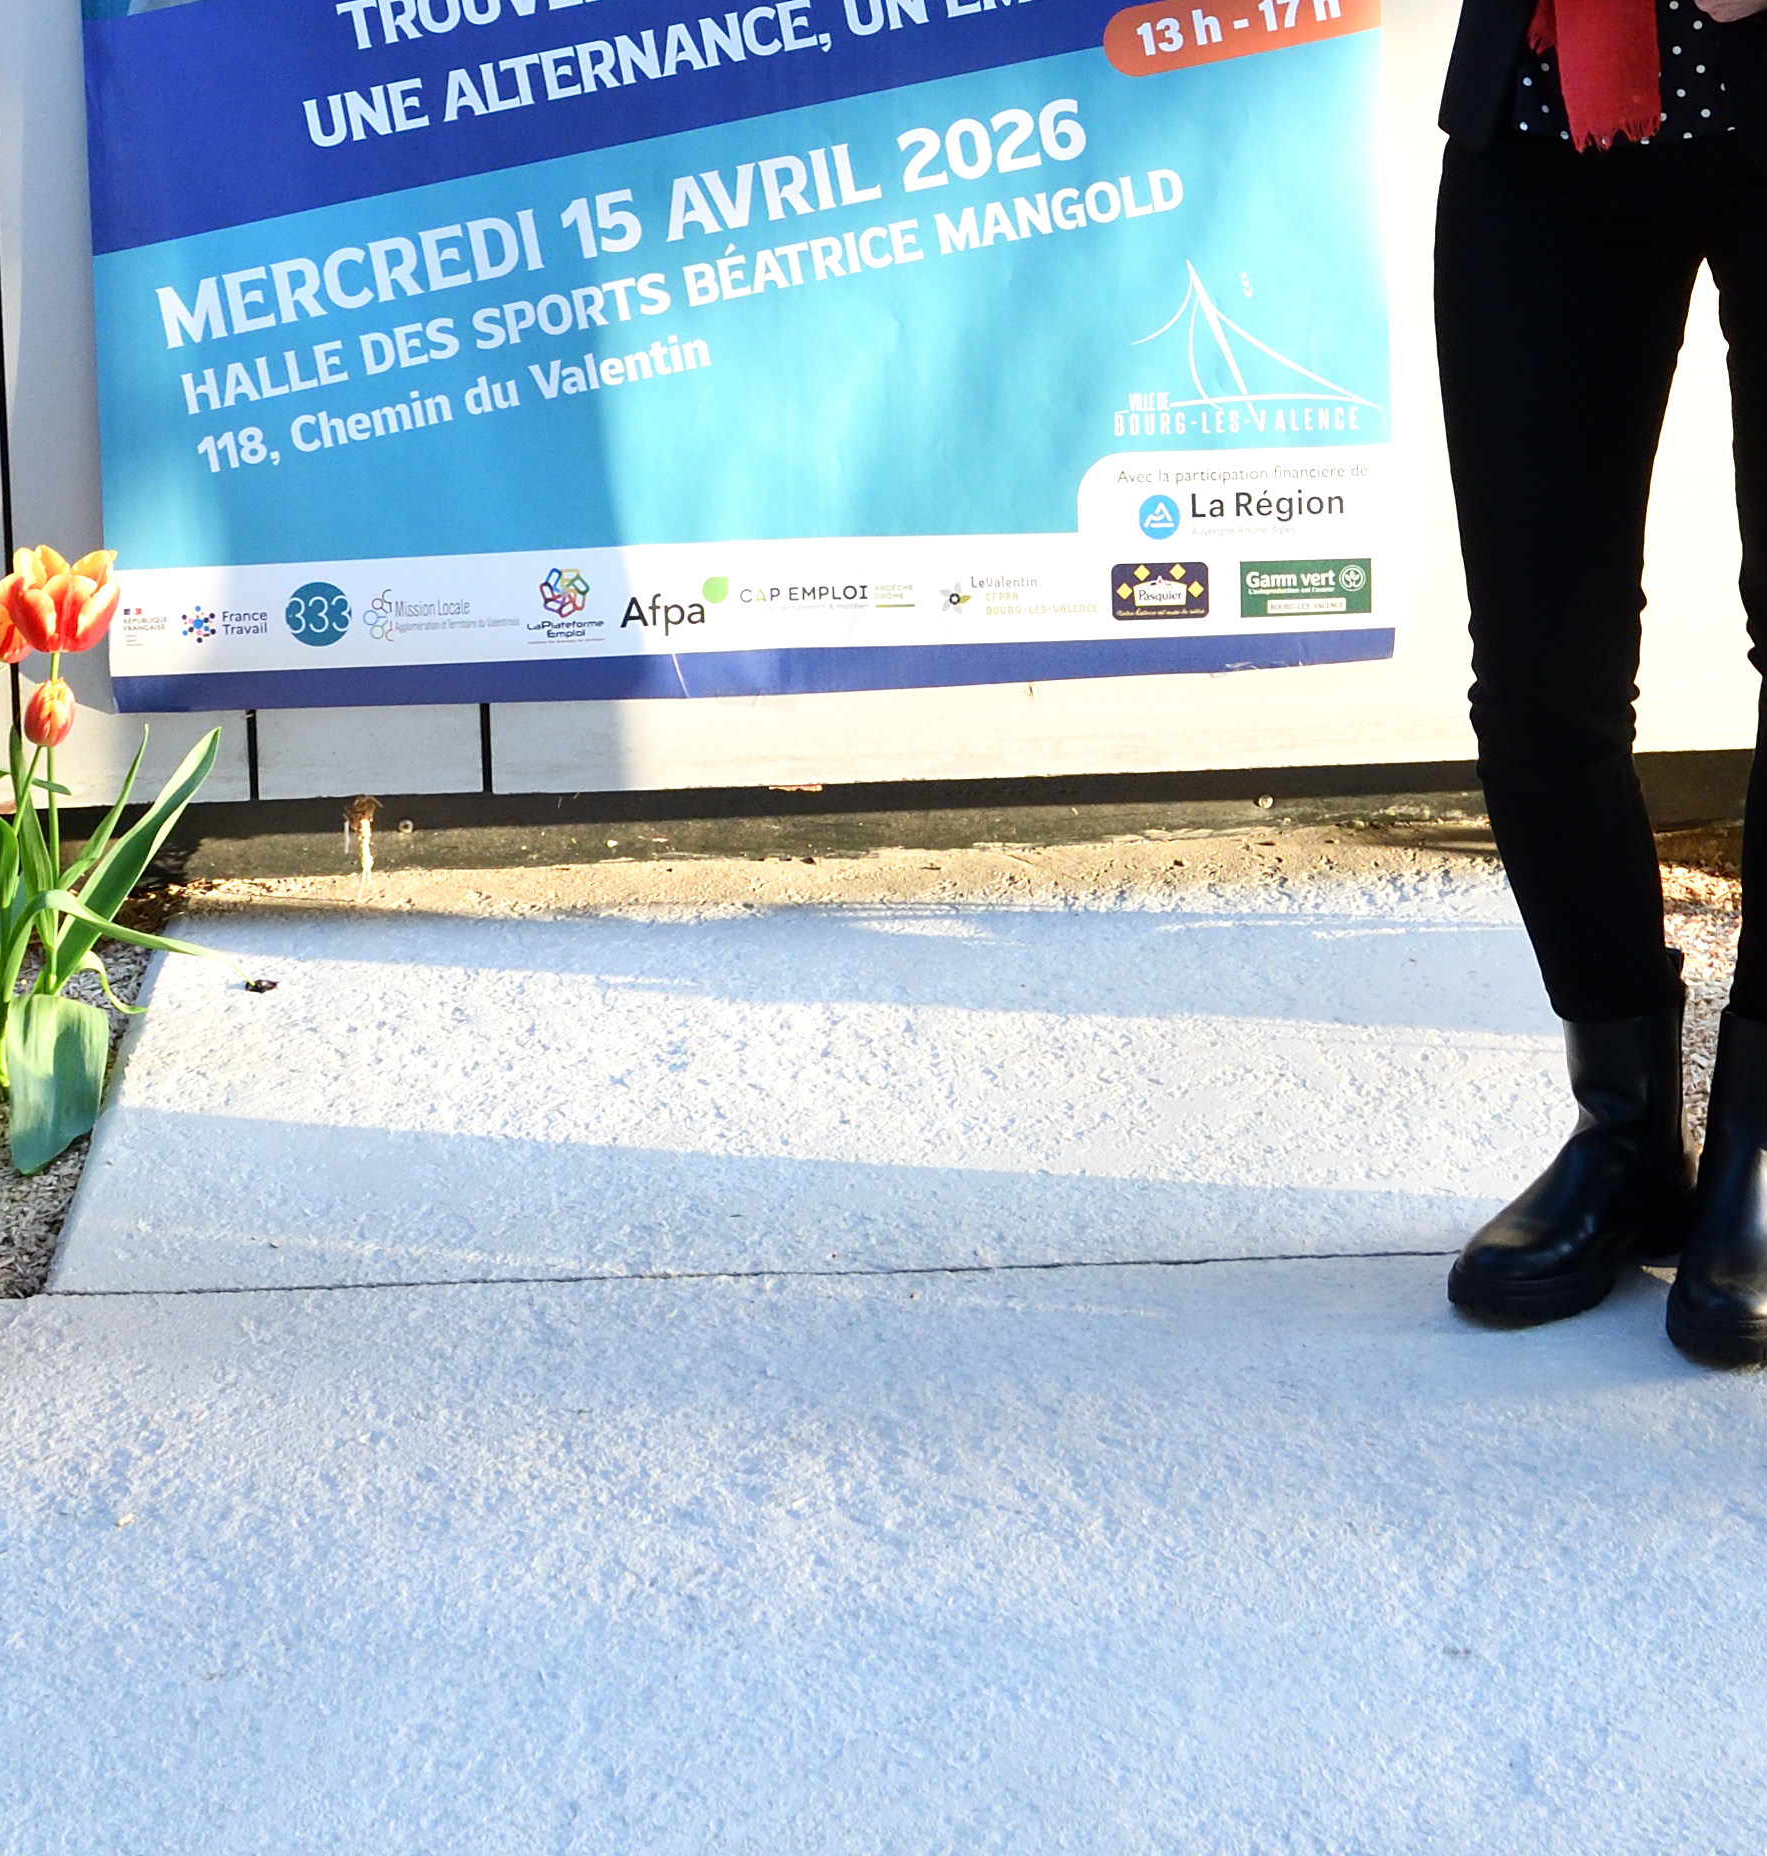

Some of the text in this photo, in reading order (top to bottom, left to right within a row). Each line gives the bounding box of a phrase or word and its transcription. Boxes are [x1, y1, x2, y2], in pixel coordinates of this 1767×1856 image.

[1135, 17, 1184, 56] 13
[1191, 8, 1222, 46] h
[302, 77, 429, 147] UNE
[155, 97, 1086, 349] MERCREDI 15 AVRIL 2026
[180, 168, 1183, 415] HALLE DES SPORTS BÉATRICE MANGOLD
[196, 334, 711, 473] 118, Chemin du Valentin
[1117, 470, 1153, 484] Avec
[1158, 468, 1170, 483] la
[1175, 467, 1269, 485] participation
[1351, 464, 1368, 477] de
[1191, 489, 1345, 522] La Région
[739, 585, 869, 604] CAP EMPLOI
[1138, 589, 1183, 603] Pasquier
[1245, 572, 1297, 589] Gamm
[1300, 570, 1336, 586] vert
[222, 610, 268, 623] France
[286, 594, 352, 634] 333
[395, 598, 471, 618] Mission Locale
[620, 593, 706, 637] Afpa
[222, 622, 268, 636] Travail
